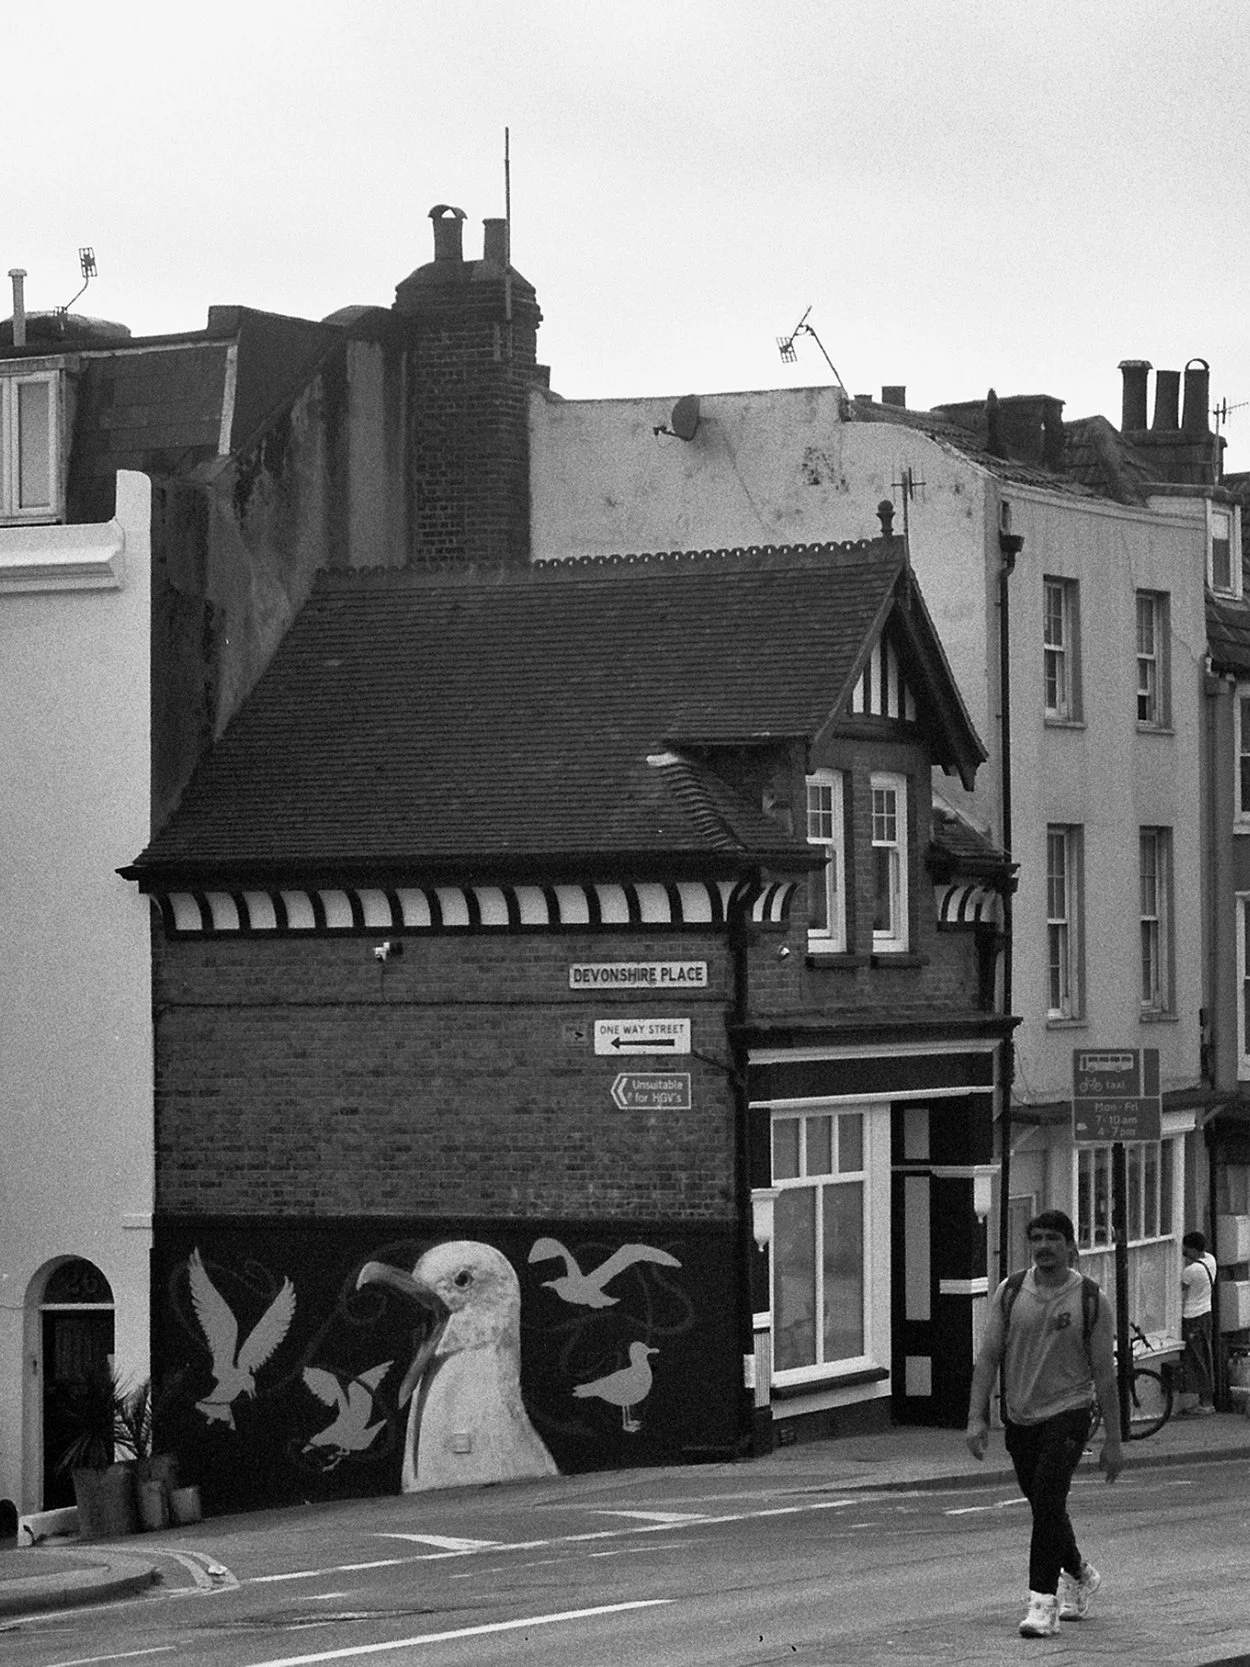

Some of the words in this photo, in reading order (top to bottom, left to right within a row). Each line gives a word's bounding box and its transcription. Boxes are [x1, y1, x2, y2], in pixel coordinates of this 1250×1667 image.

[573, 966, 657, 983] DEVONSHIRE
[660, 966, 704, 982] PLACE
[600, 1025, 620, 1035] ONE
[623, 1024, 645, 1035] WAY
[648, 1023, 685, 1034] STREET
[632, 1078, 684, 1090] Unsuitable
[634, 1092, 649, 1103] for
[1094, 1101, 1117, 1112] Mon
